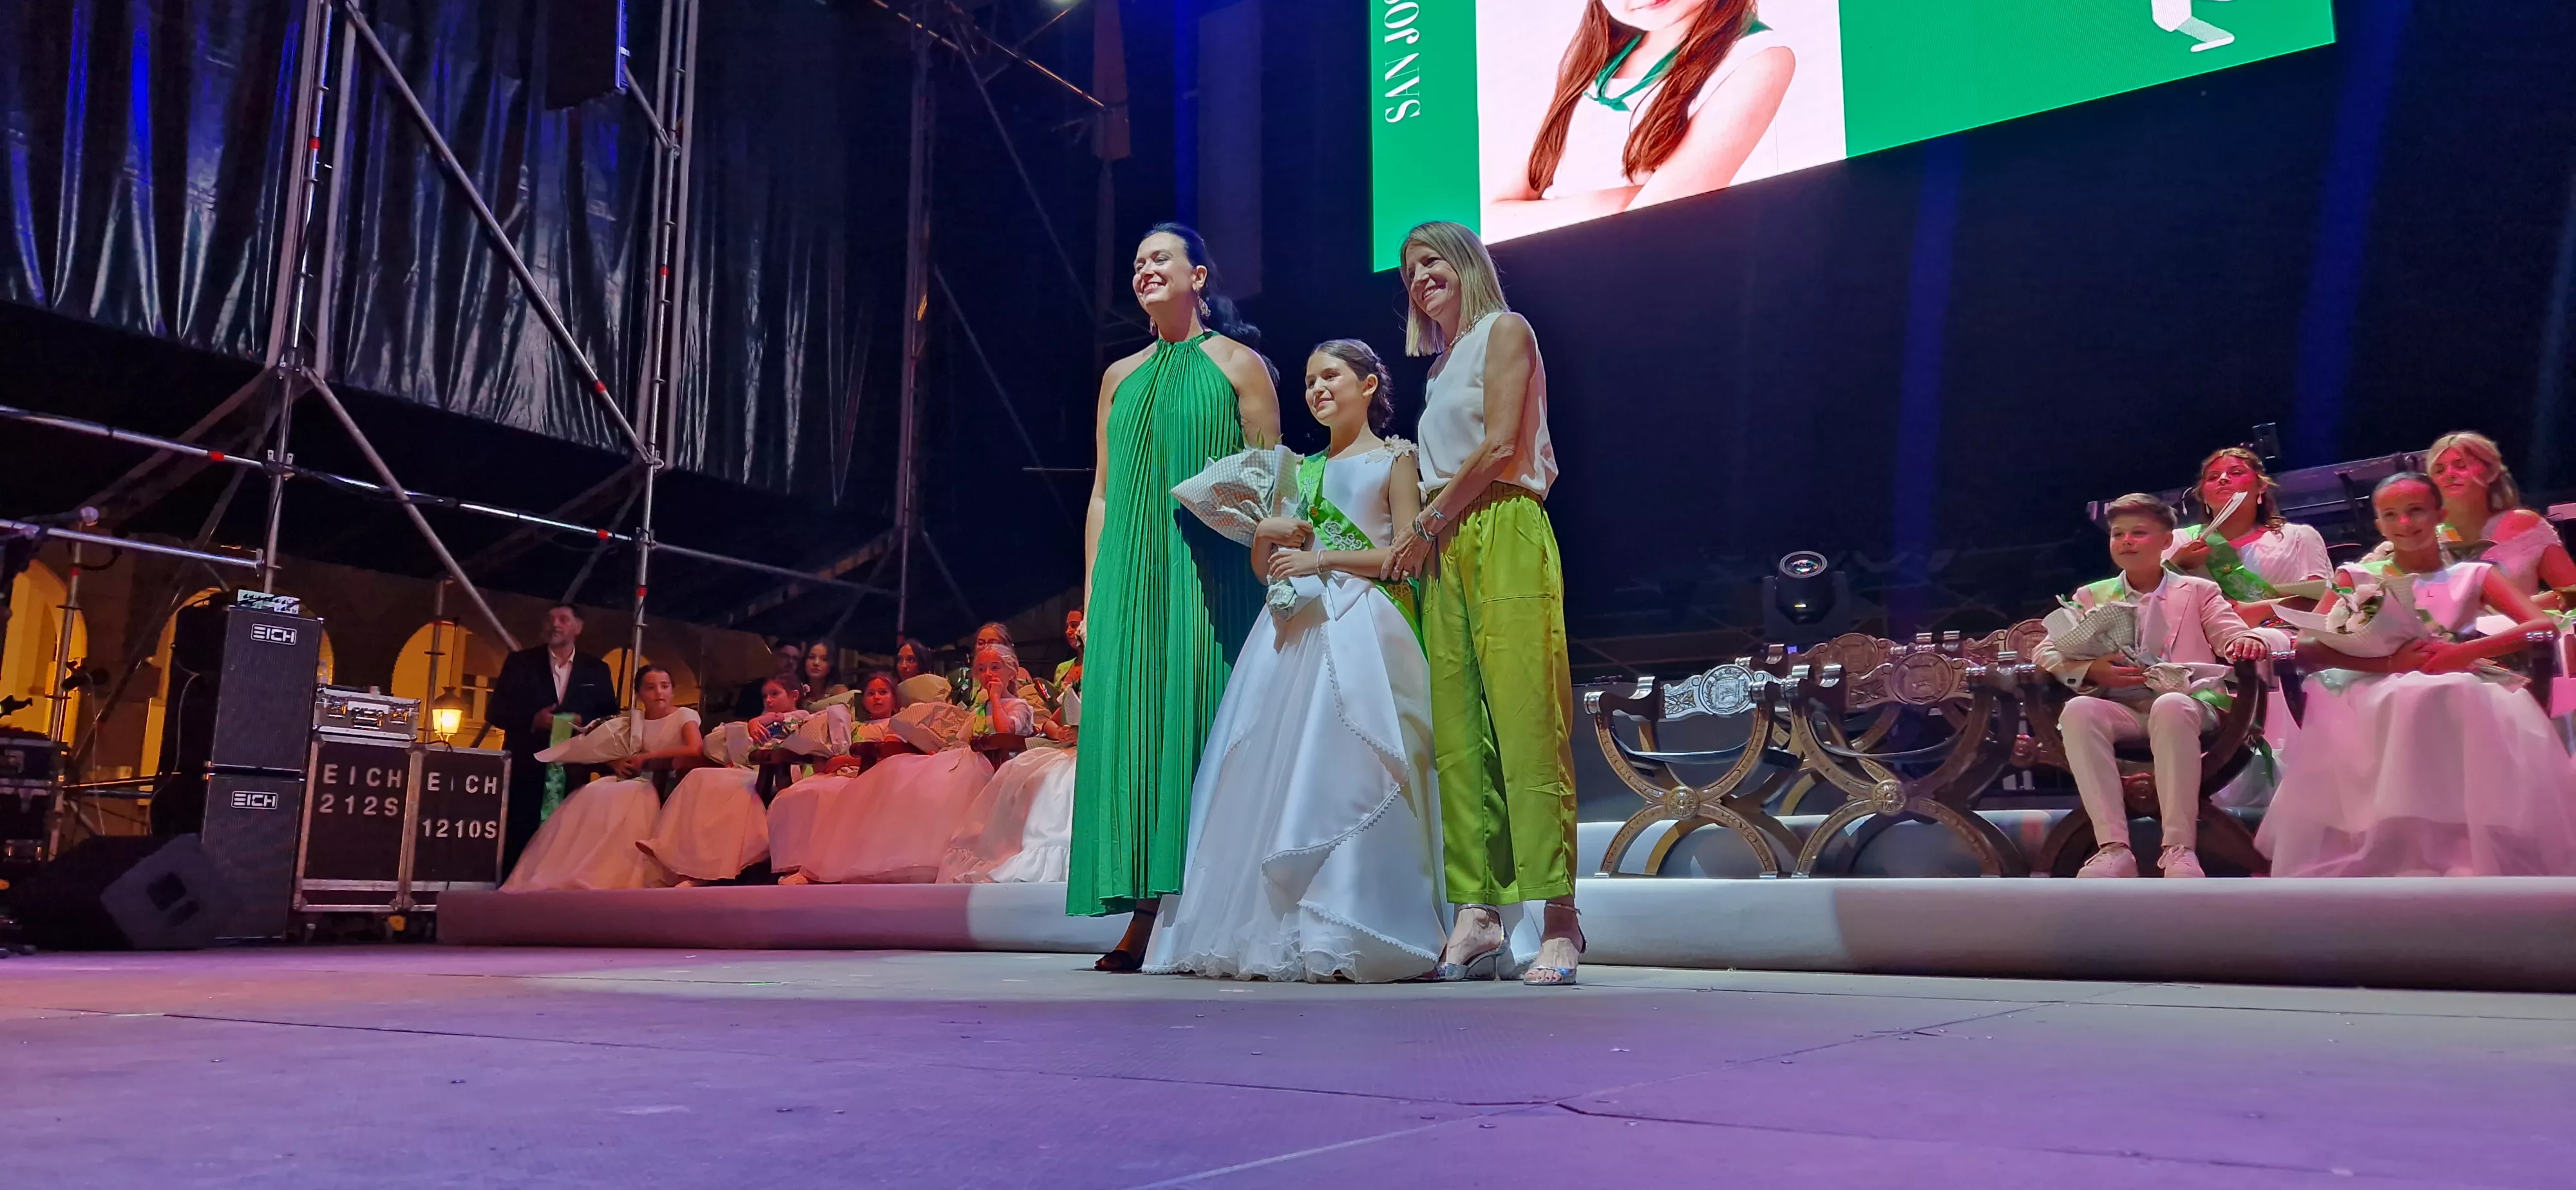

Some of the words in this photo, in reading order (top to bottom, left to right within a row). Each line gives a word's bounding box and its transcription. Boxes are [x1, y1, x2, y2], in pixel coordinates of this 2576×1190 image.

[1384, 0, 1420, 44] JO
[1384, 52, 1421, 123] SAN
[252, 626, 295, 643] EICH
[323, 764, 402, 788] EICH
[427, 772, 498, 795] EICH
[233, 793, 276, 808] EICH
[319, 793, 399, 817] 212S
[422, 818, 498, 839] 1210S
